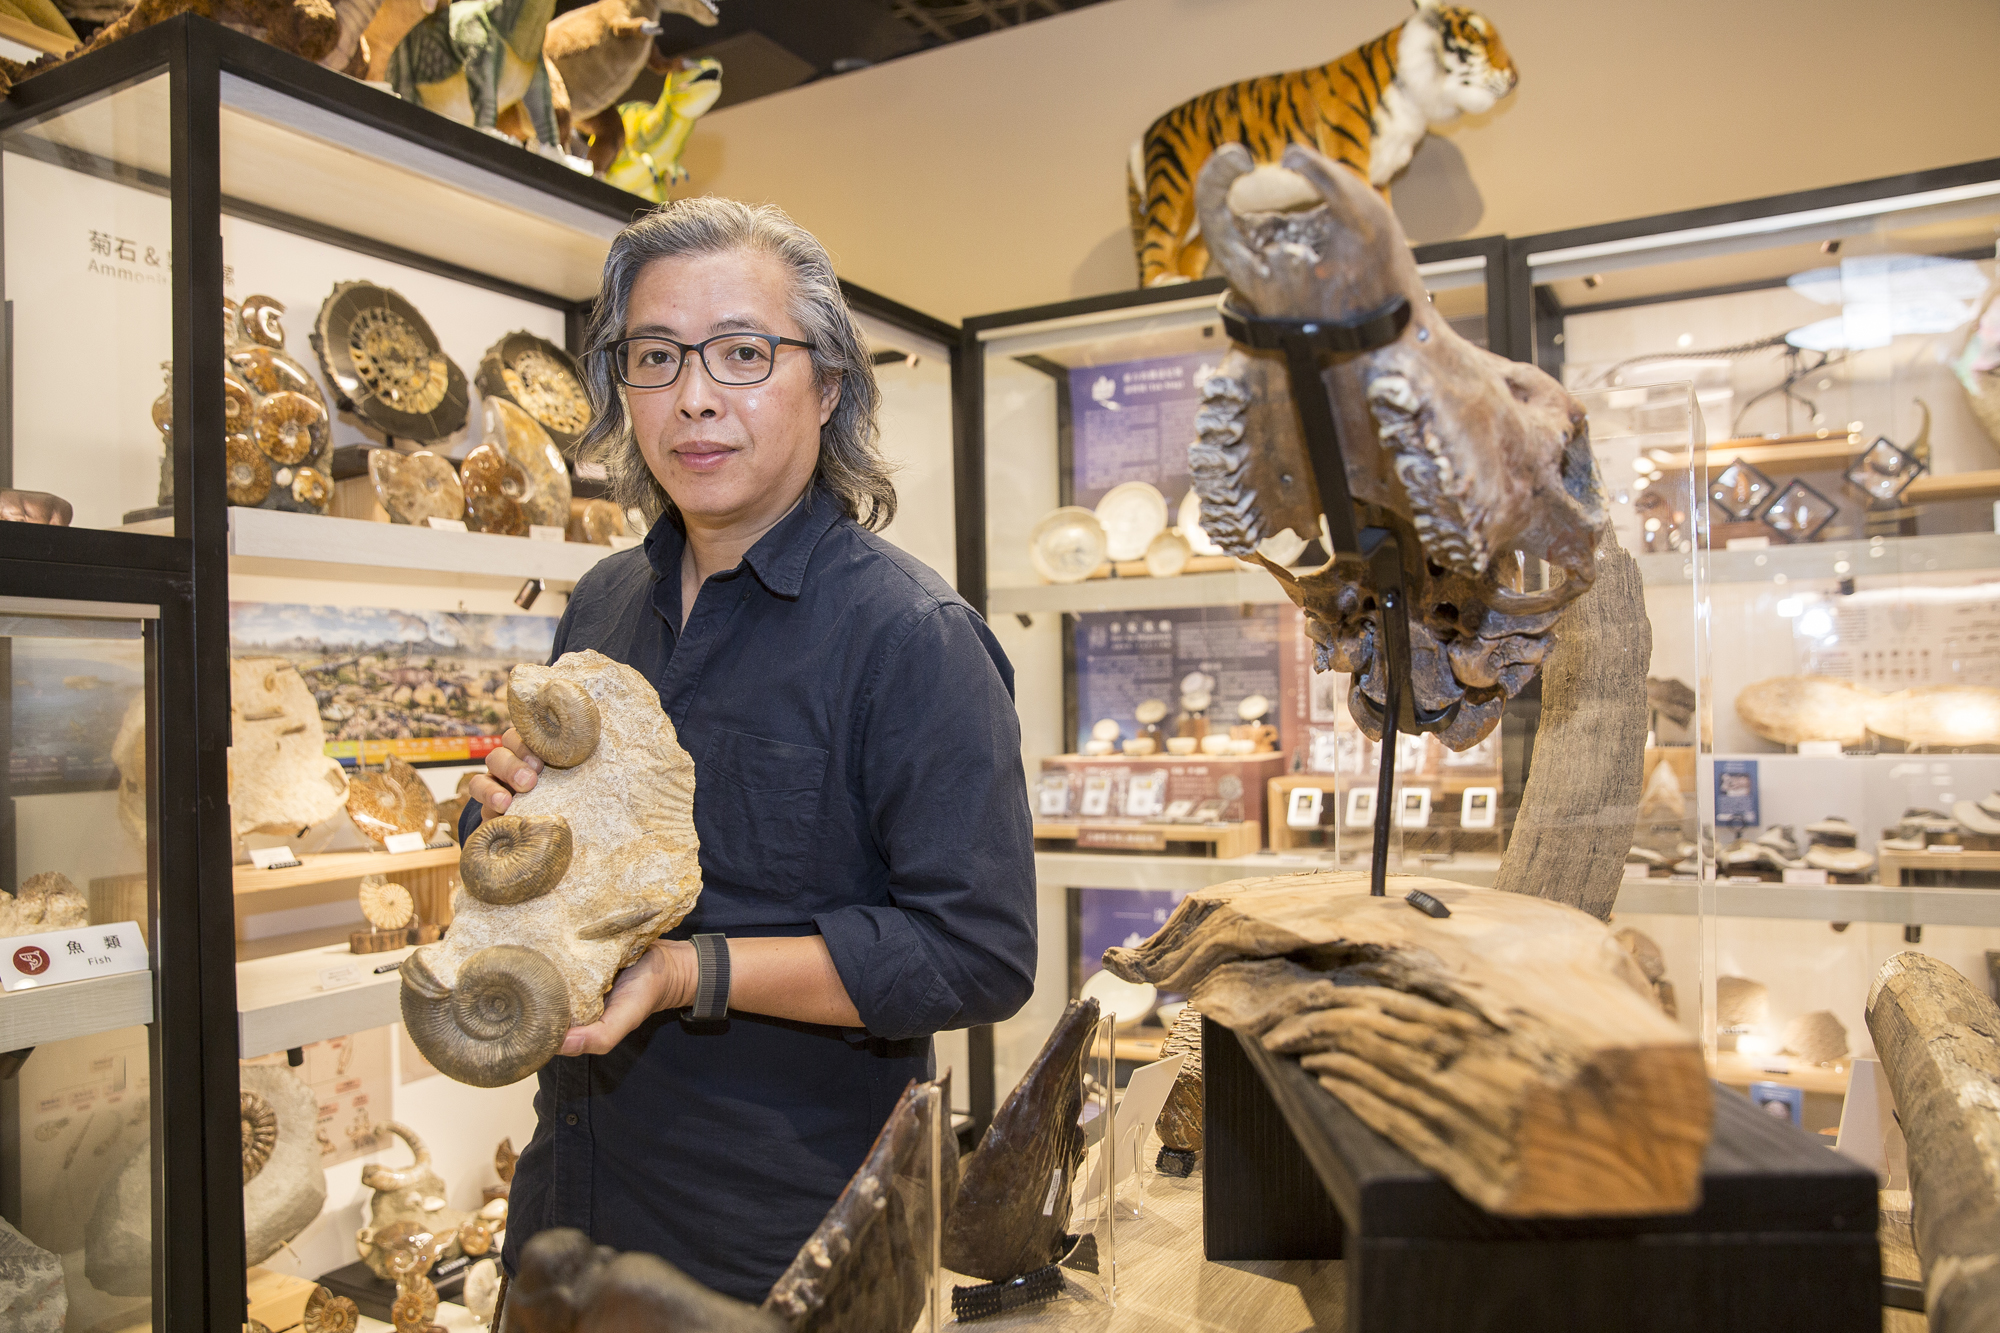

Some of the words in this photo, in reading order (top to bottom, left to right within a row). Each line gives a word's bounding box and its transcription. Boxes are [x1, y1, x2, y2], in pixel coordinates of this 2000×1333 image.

[89, 229, 136, 263] 菊石
[144, 245, 161, 267] &
[87, 955, 112, 966] Fish
